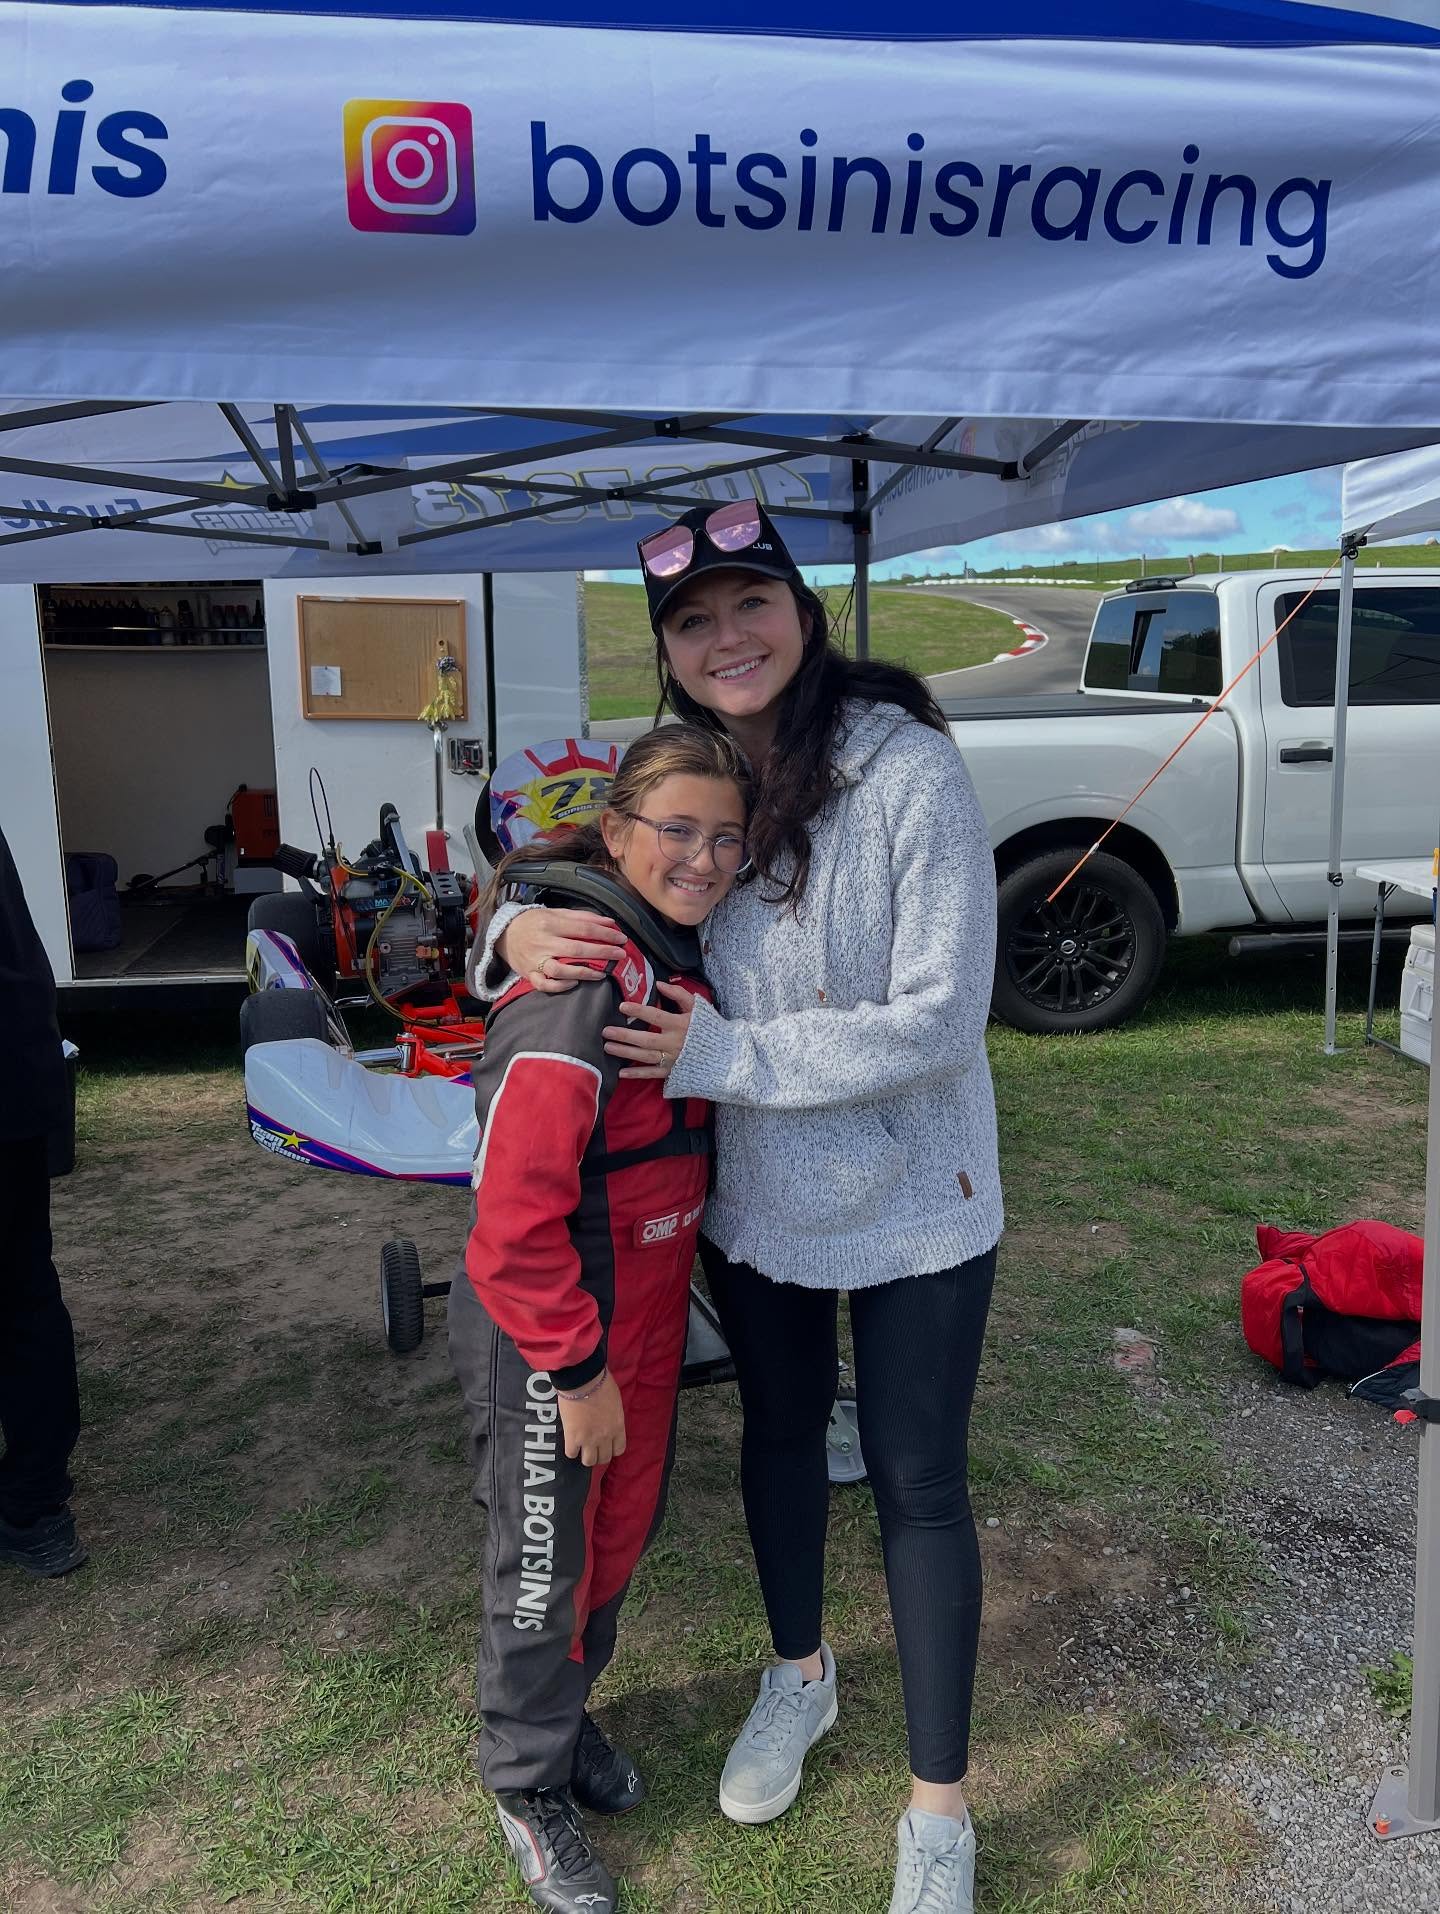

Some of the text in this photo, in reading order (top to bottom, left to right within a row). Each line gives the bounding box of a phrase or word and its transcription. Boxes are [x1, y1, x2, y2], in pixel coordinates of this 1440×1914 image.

[529, 120, 1332, 279] botsinisracing
[642, 1215, 678, 1241] OMP
[512, 1493, 555, 1633] BOTSINIS
